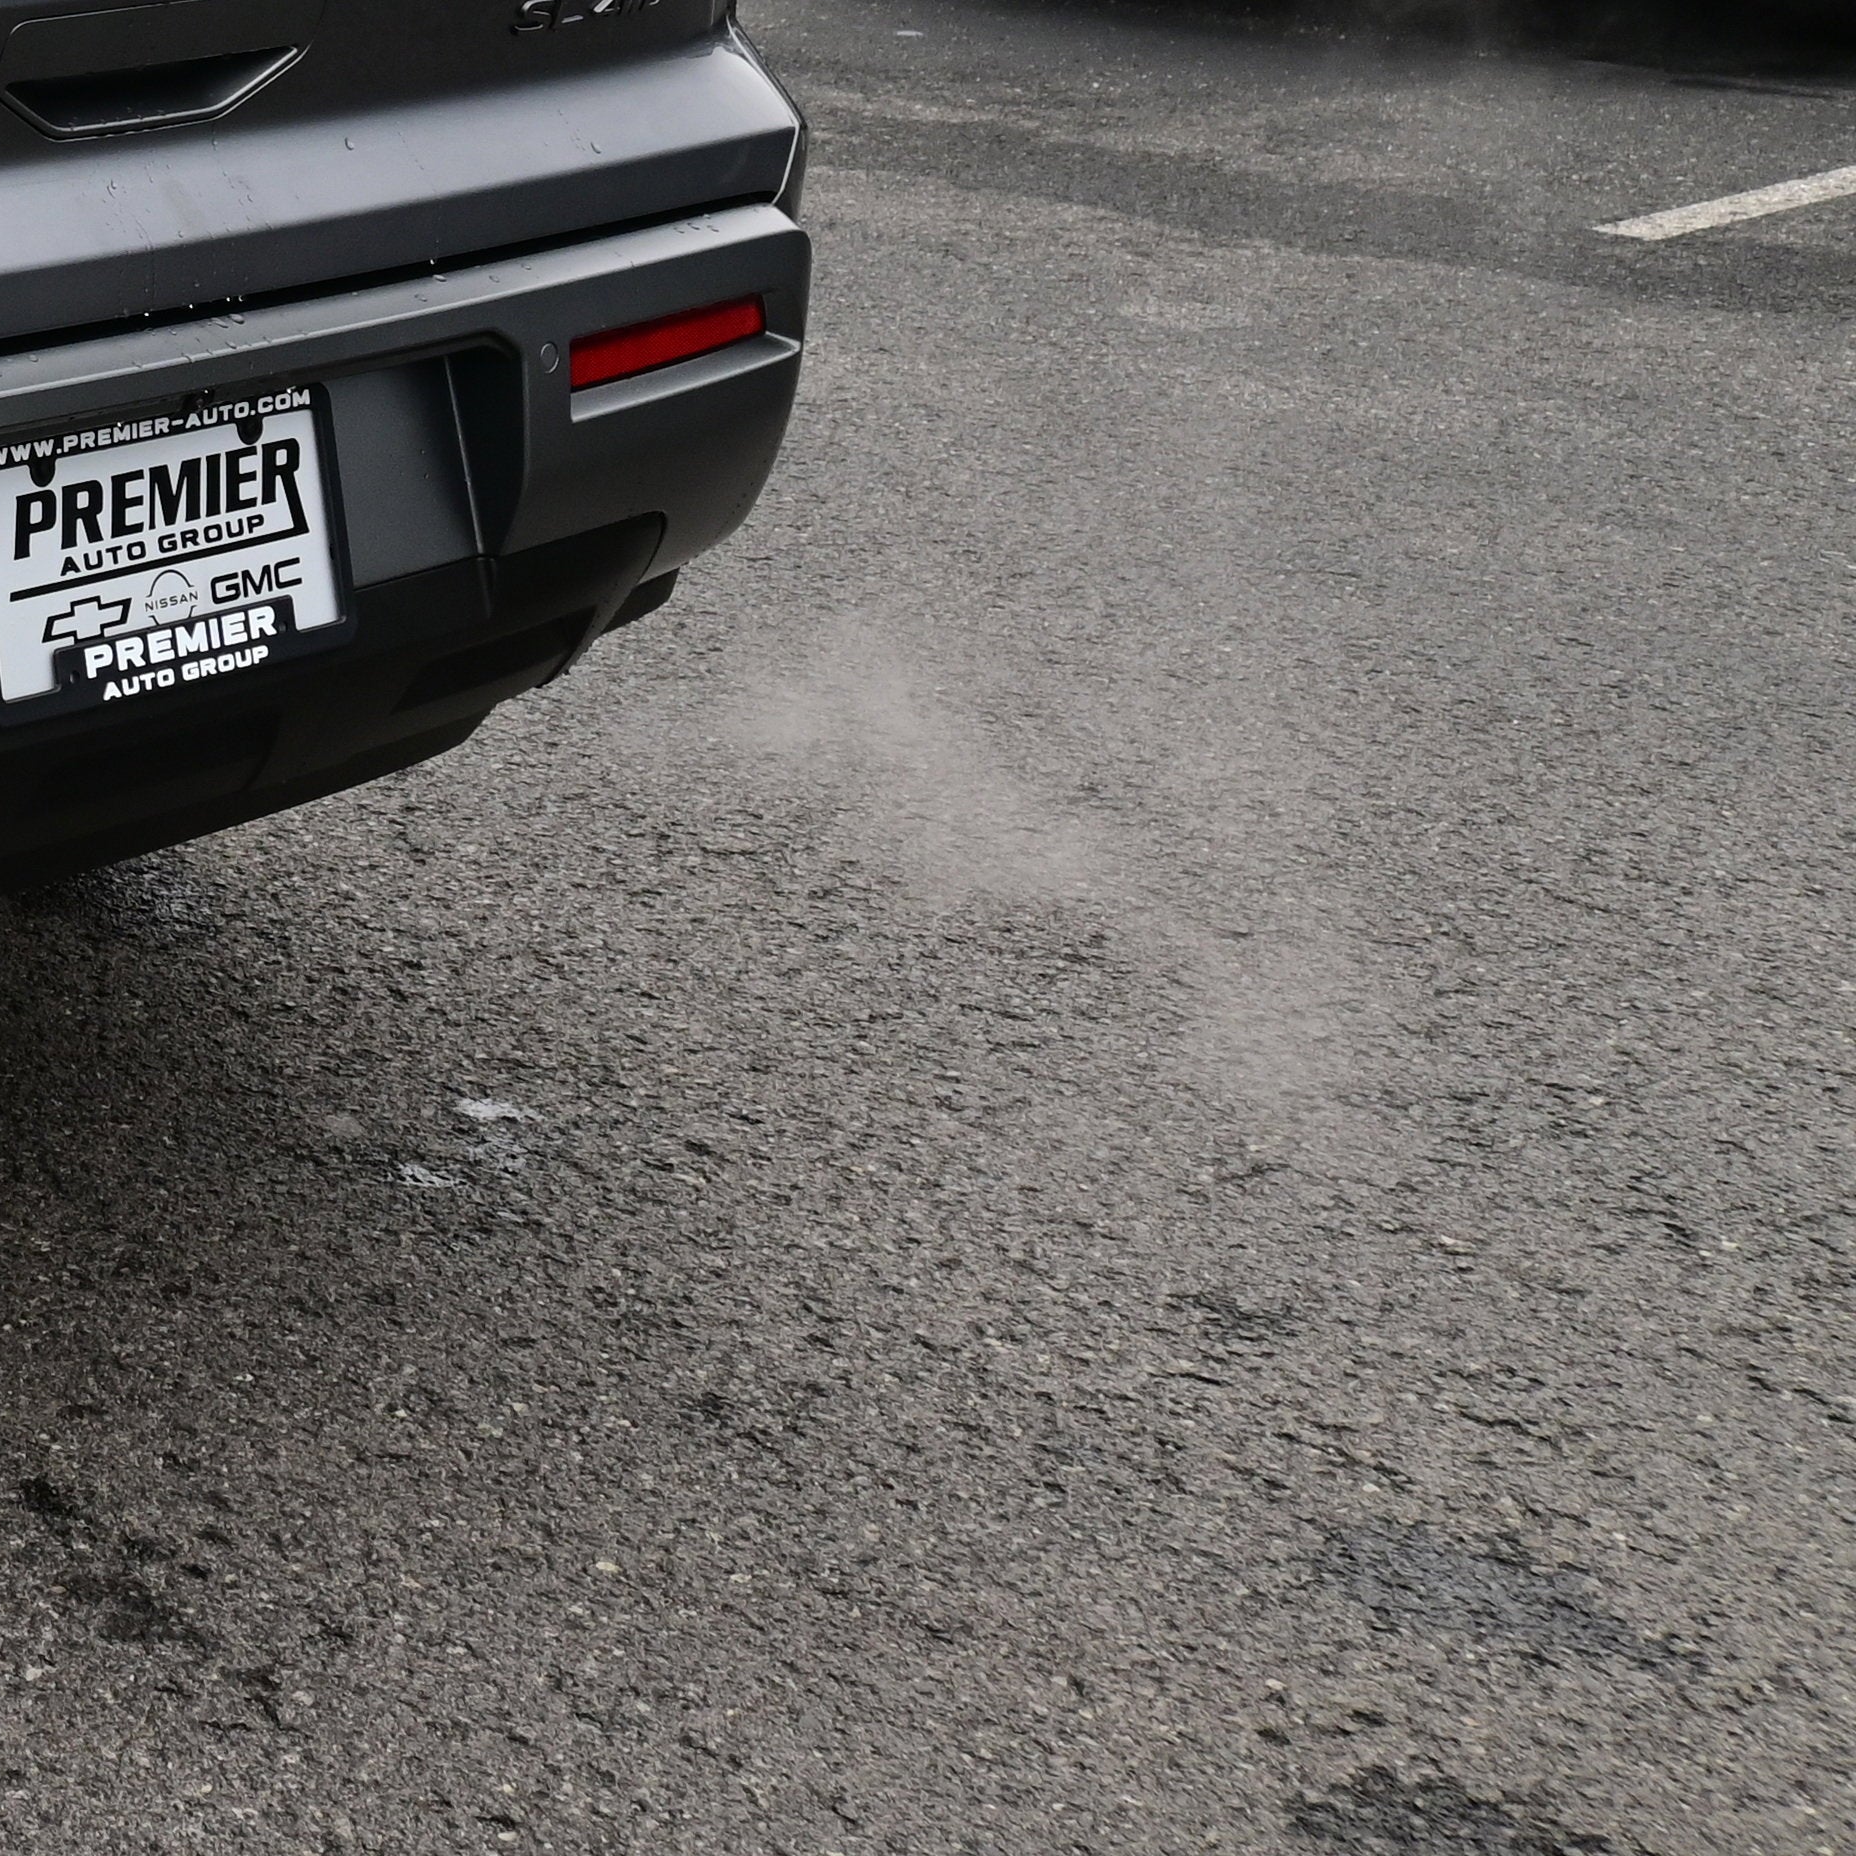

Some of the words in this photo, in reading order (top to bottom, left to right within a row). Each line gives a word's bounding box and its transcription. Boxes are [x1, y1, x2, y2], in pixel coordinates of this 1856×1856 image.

[14, 437, 310, 561] PREMIER
[60, 539, 147, 577] AUTO
[157, 513, 266, 555] GROUP
[144, 589, 199, 613] NISSAN
[210, 556, 303, 605] GMC
[84, 604, 278, 679] PREMIER
[102, 667, 176, 702] AUTO
[181, 644, 270, 682] GROUP
